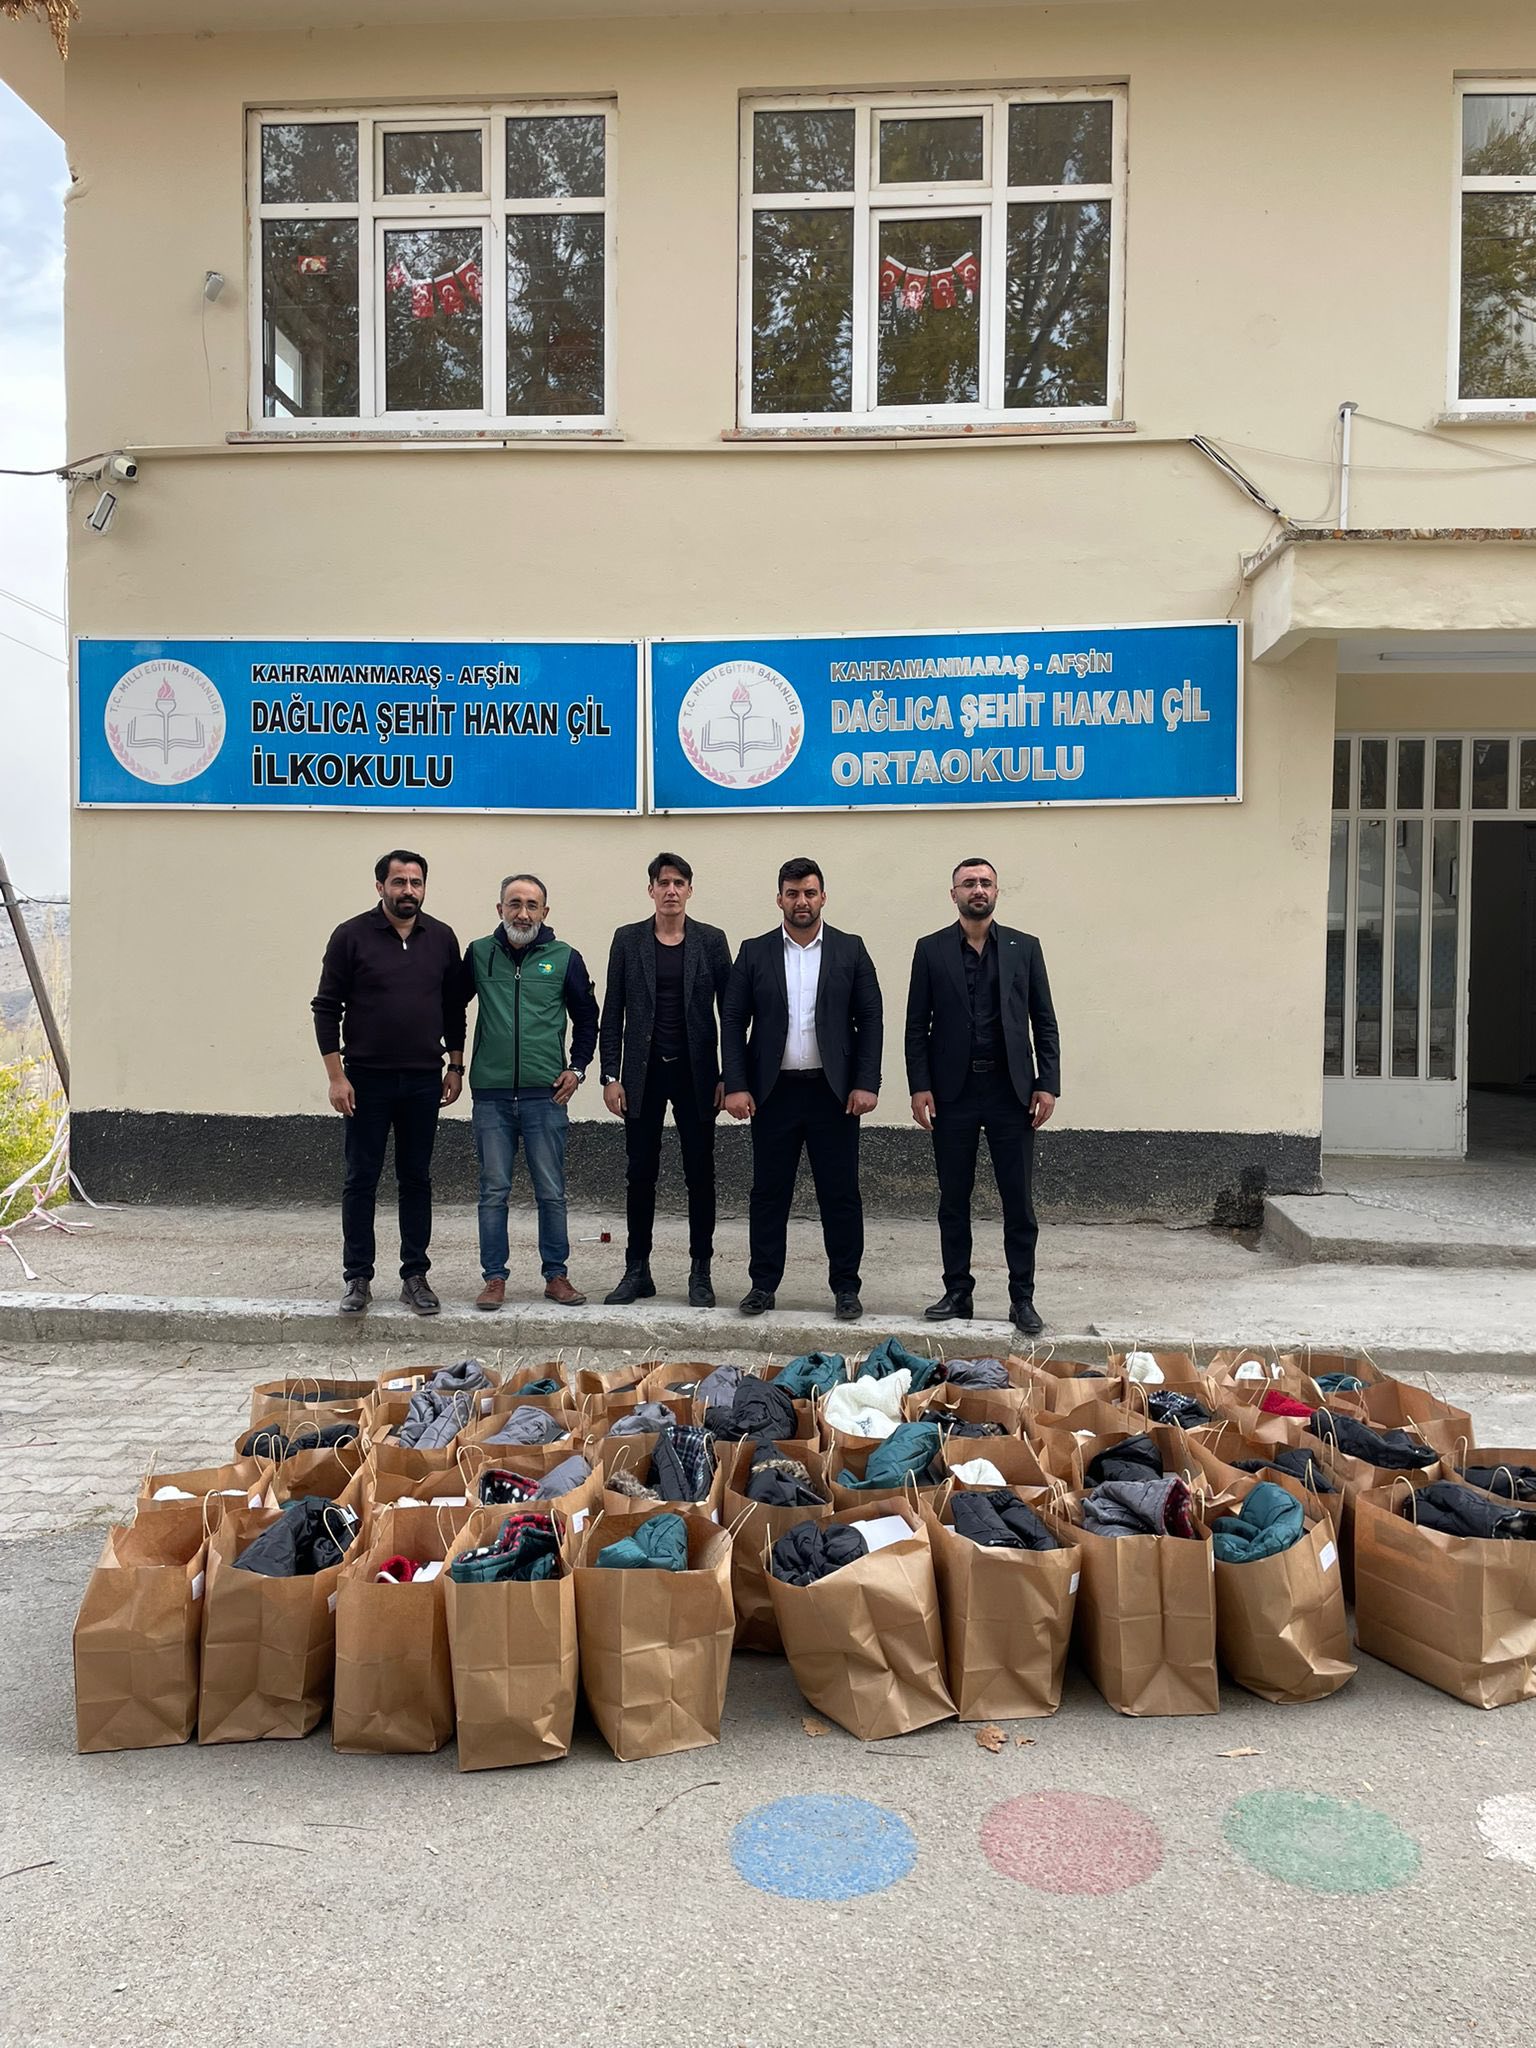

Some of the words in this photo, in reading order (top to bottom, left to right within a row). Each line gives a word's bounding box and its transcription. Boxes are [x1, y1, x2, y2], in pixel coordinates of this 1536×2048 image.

[252, 664, 441, 689] KAHRAMANMARAŞ
[458, 662, 520, 689] AFŞİN
[830, 654, 1029, 682] KAHRAMANMARAŞ
[1046, 648, 1112, 678] AFŞİN
[252, 693, 369, 734] DAĞLICA
[376, 695, 456, 743] ŞEHİT
[464, 702, 558, 736] HAKAN
[566, 695, 611, 744] ÇİL
[831, 690, 954, 733] DAĞLICA
[960, 685, 1045, 738] ŞEHİT
[1053, 689, 1154, 726] HAKAN
[1162, 679, 1210, 732] ÇİL
[253, 745, 454, 789] İLKOKULU
[831, 746, 1085, 787] ORTAOKULU
